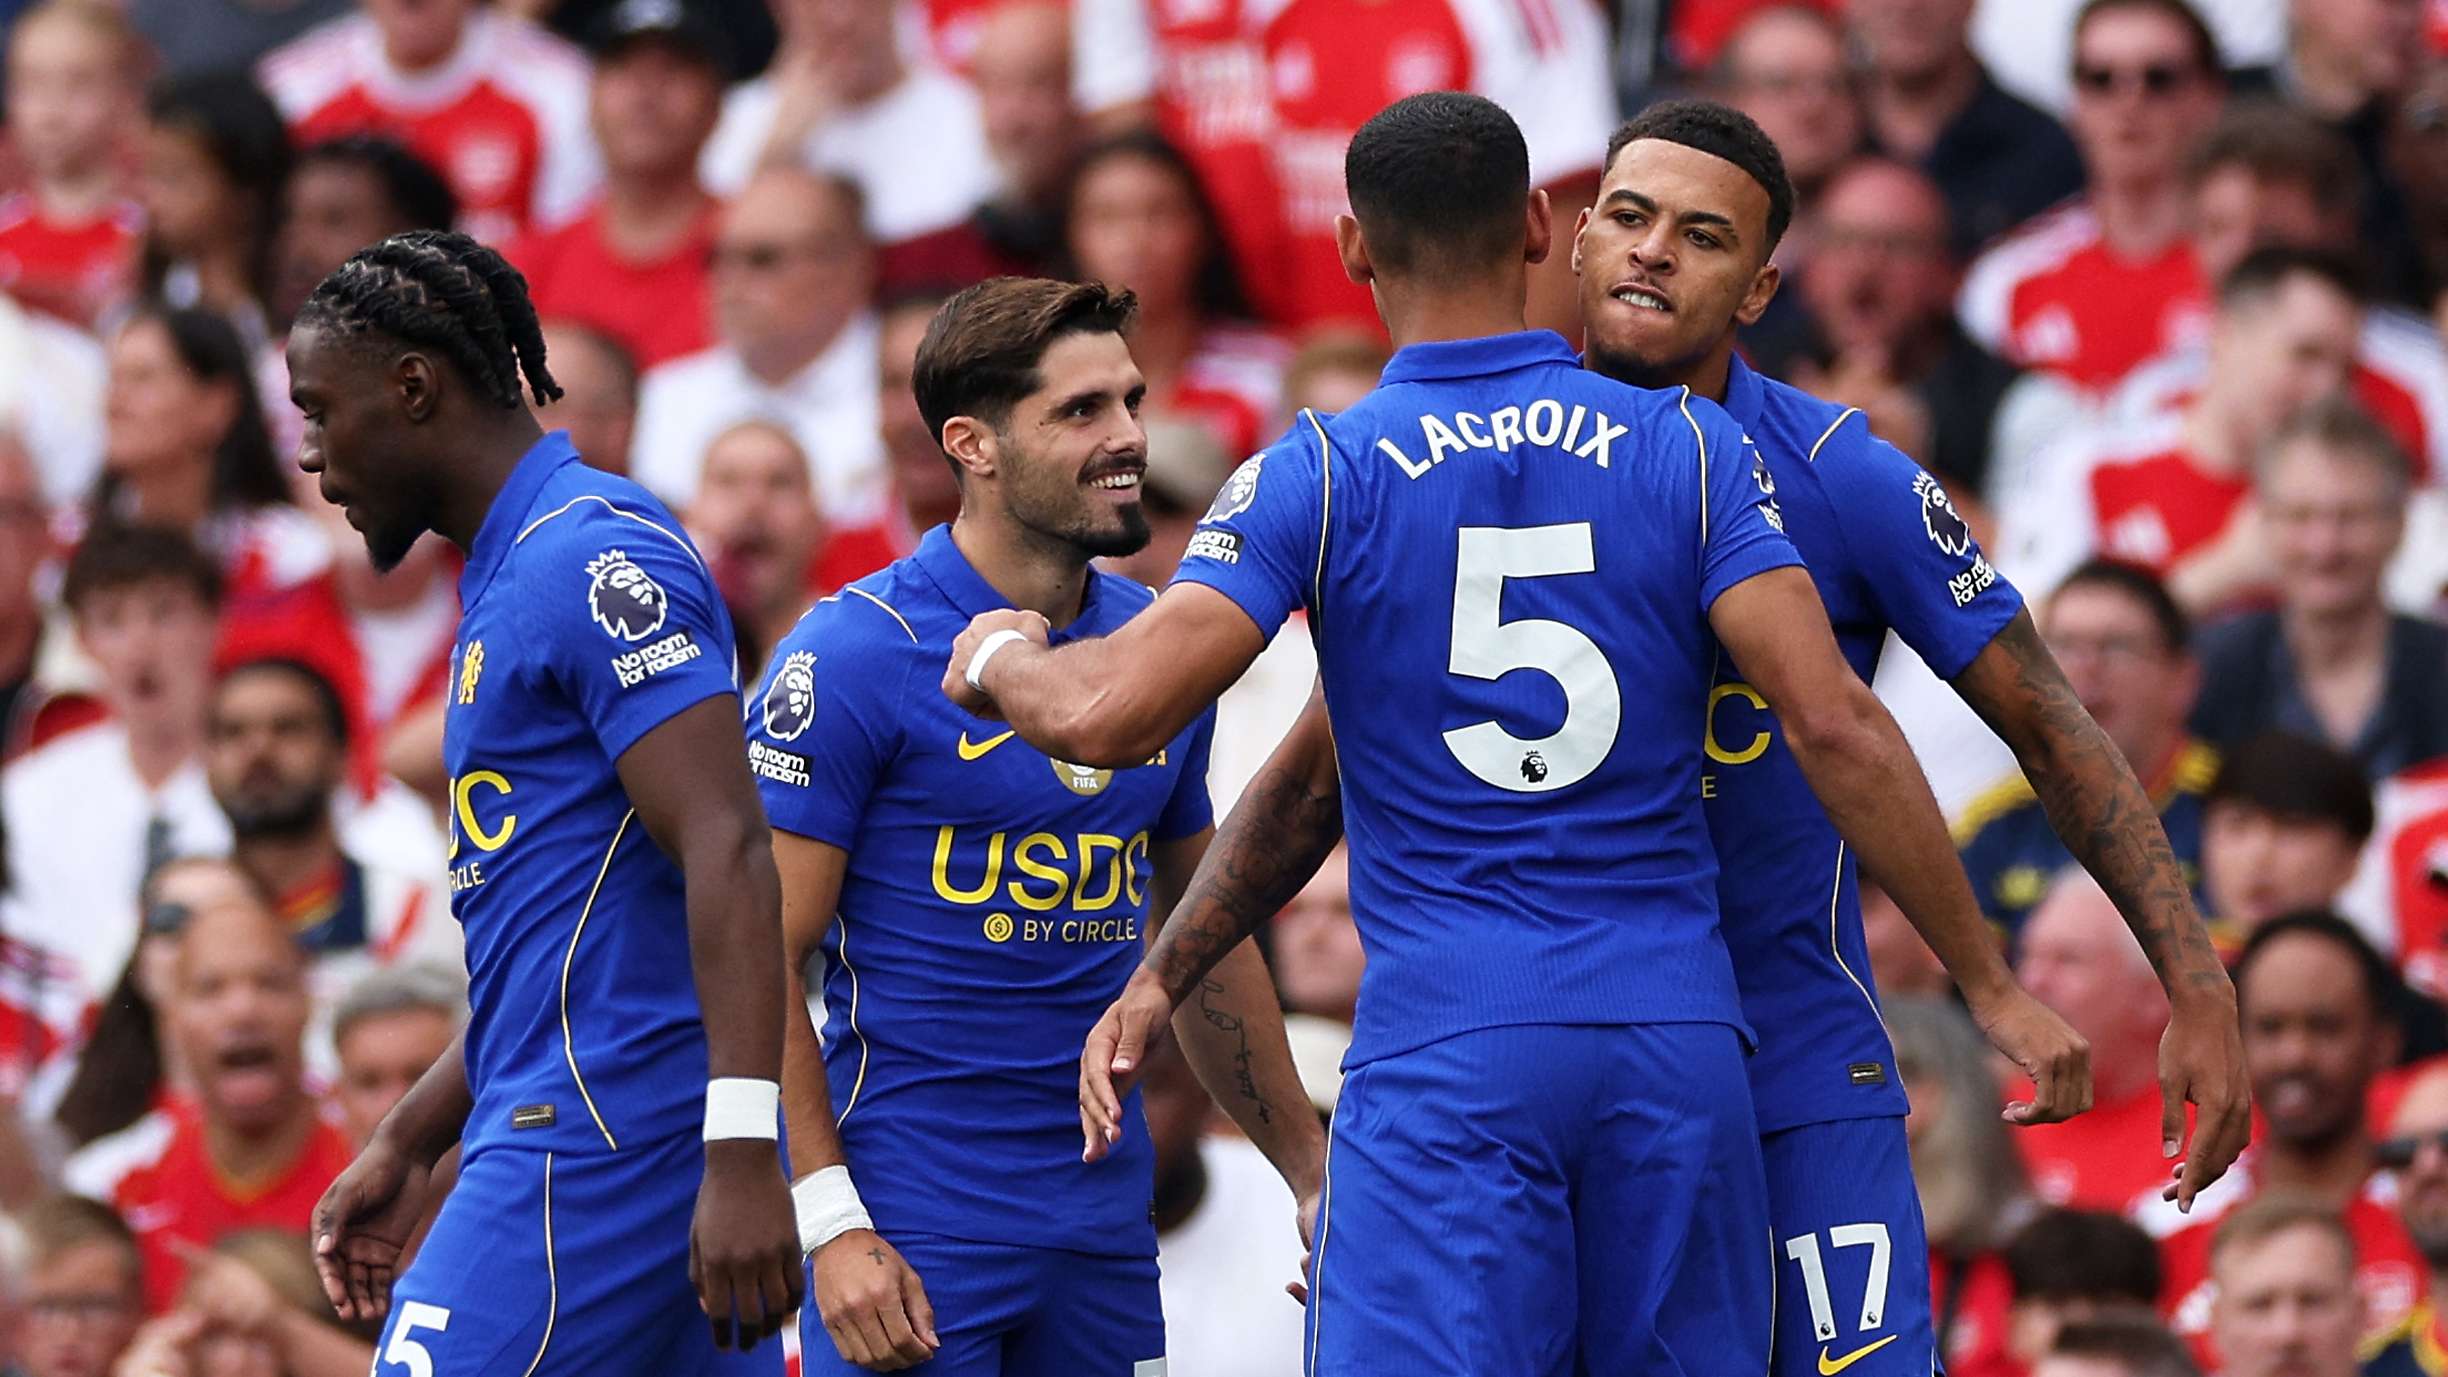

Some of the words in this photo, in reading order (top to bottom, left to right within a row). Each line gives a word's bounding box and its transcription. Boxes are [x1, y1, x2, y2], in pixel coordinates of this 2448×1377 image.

[1376, 399, 1630, 481] LACROIX
[1948, 573, 1972, 594] No
[1953, 584, 1976, 608] for
[611, 653, 642, 674] No
[640, 632, 688, 662] room
[618, 665, 645, 688] for
[645, 643, 702, 676] racism
[1442, 521, 1621, 792] 5
[760, 760, 811, 788] racism
[764, 747, 805, 772] room
[1072, 776, 1099, 789] FIFA
[931, 824, 1152, 912] USDC
[1023, 919, 1056, 942] BY
[1062, 918, 1138, 944] CIRCLE
[1785, 1222, 1891, 1343] 17
